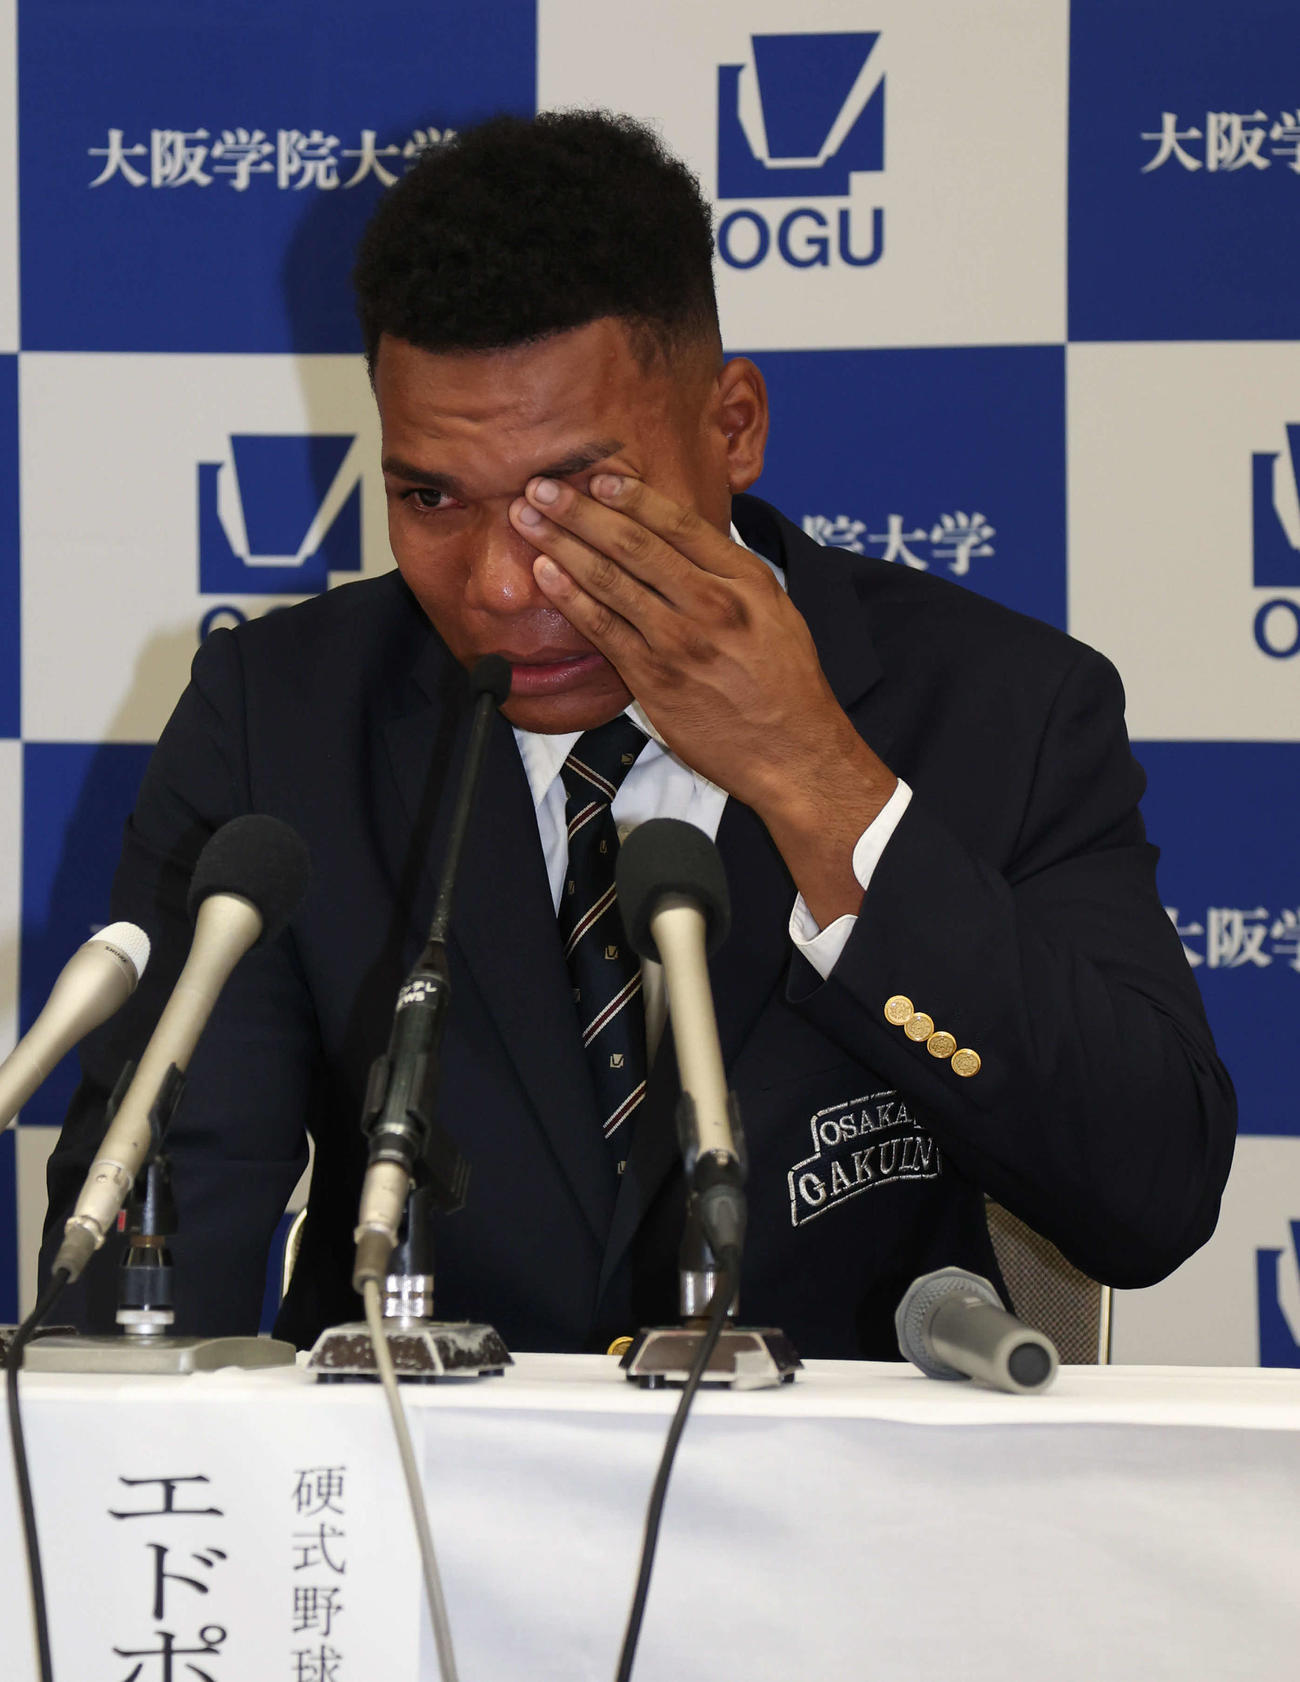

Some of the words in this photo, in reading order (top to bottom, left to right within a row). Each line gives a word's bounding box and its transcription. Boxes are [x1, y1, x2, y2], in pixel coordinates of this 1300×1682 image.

[717, 206, 884, 270] OGU
[819, 1101, 913, 1146] OSAKA
[798, 1136, 934, 1207] GAKUIN
[108, 1475, 227, 1682] エドポ
[291, 1465, 346, 1682] 硬式野球
